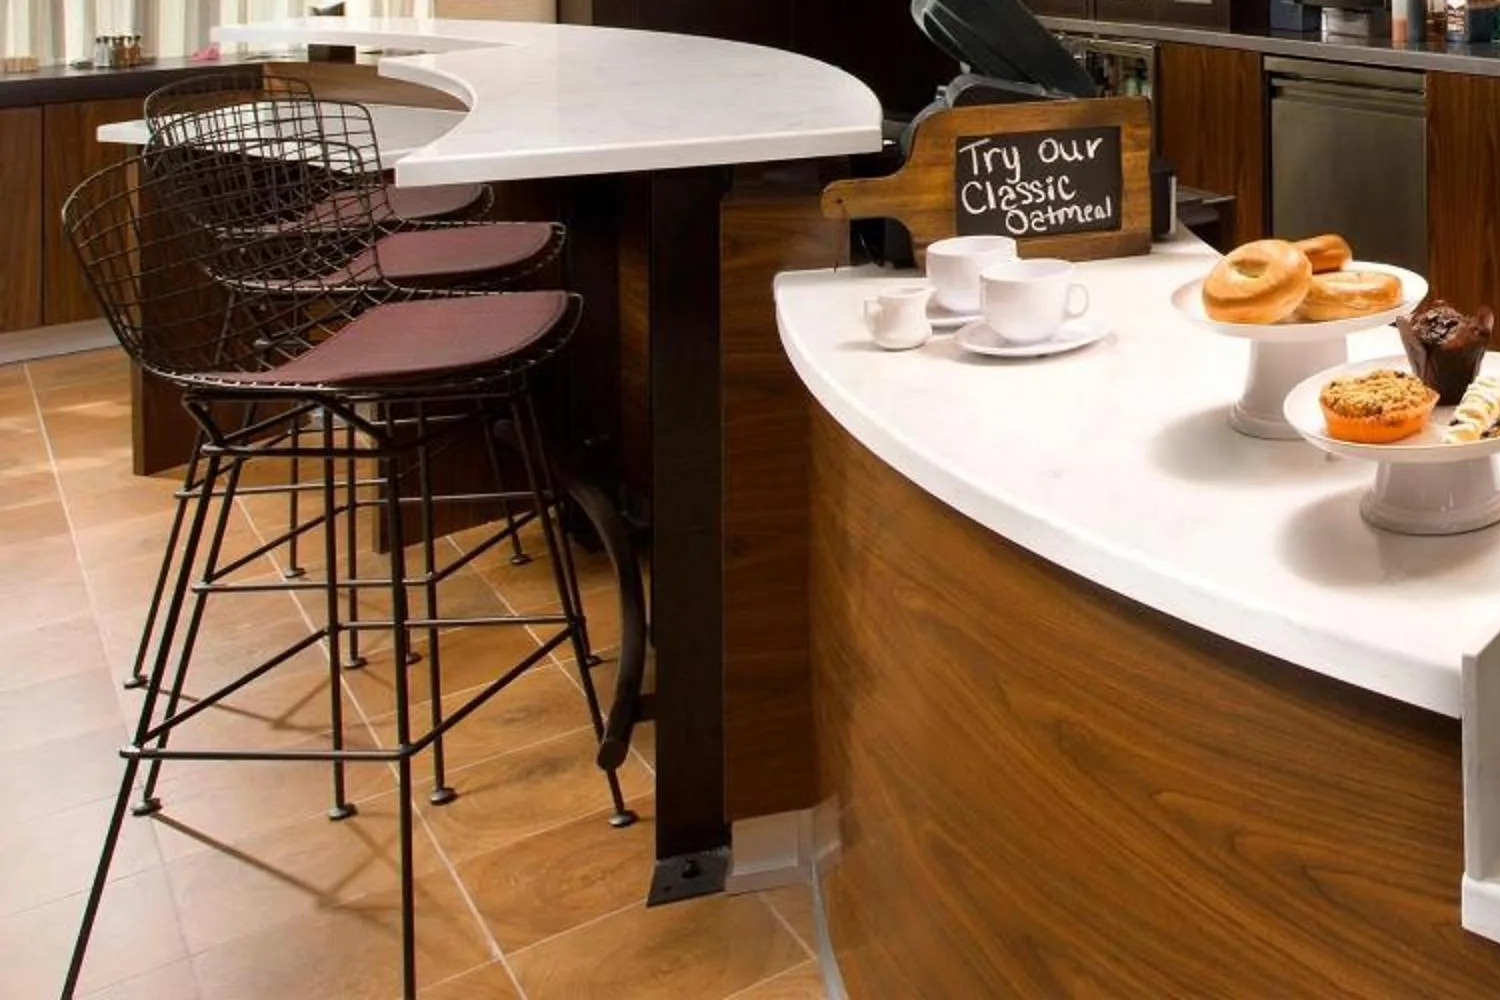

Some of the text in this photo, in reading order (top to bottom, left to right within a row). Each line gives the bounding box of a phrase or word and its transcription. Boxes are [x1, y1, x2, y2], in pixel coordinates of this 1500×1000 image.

[959, 137, 1020, 185] Try
[961, 174, 1077, 215] Classic
[1005, 196, 1112, 235] Oatmeal
